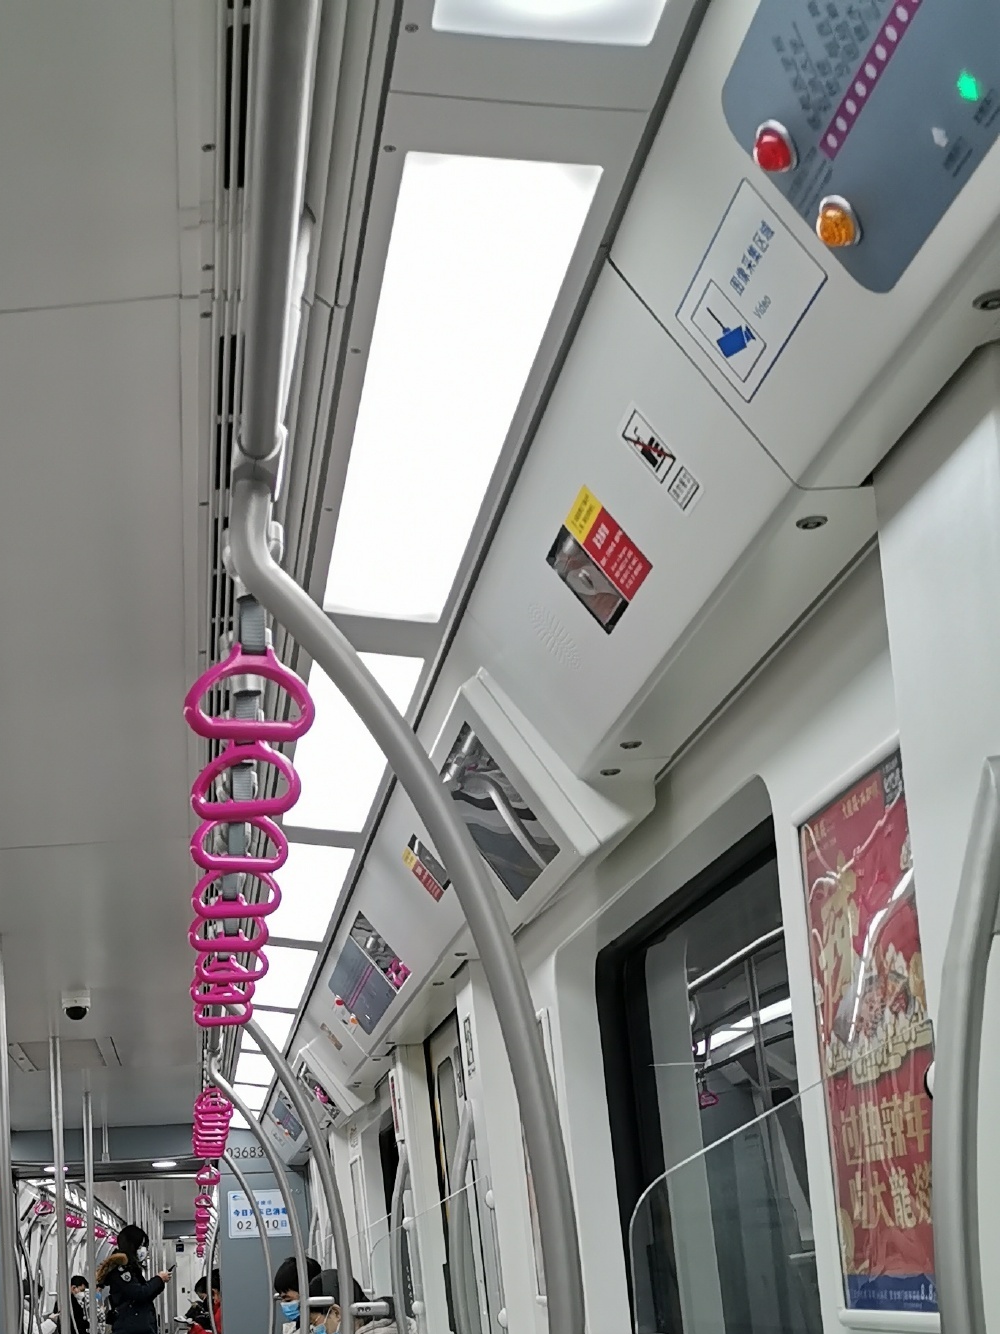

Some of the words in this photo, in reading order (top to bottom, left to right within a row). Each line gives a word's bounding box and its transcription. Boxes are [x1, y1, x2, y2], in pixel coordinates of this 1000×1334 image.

[752, 295, 772, 319] Video
[840, 1090, 931, 1166] 过热辣年
[237, 1219, 287, 1230] 0210日
